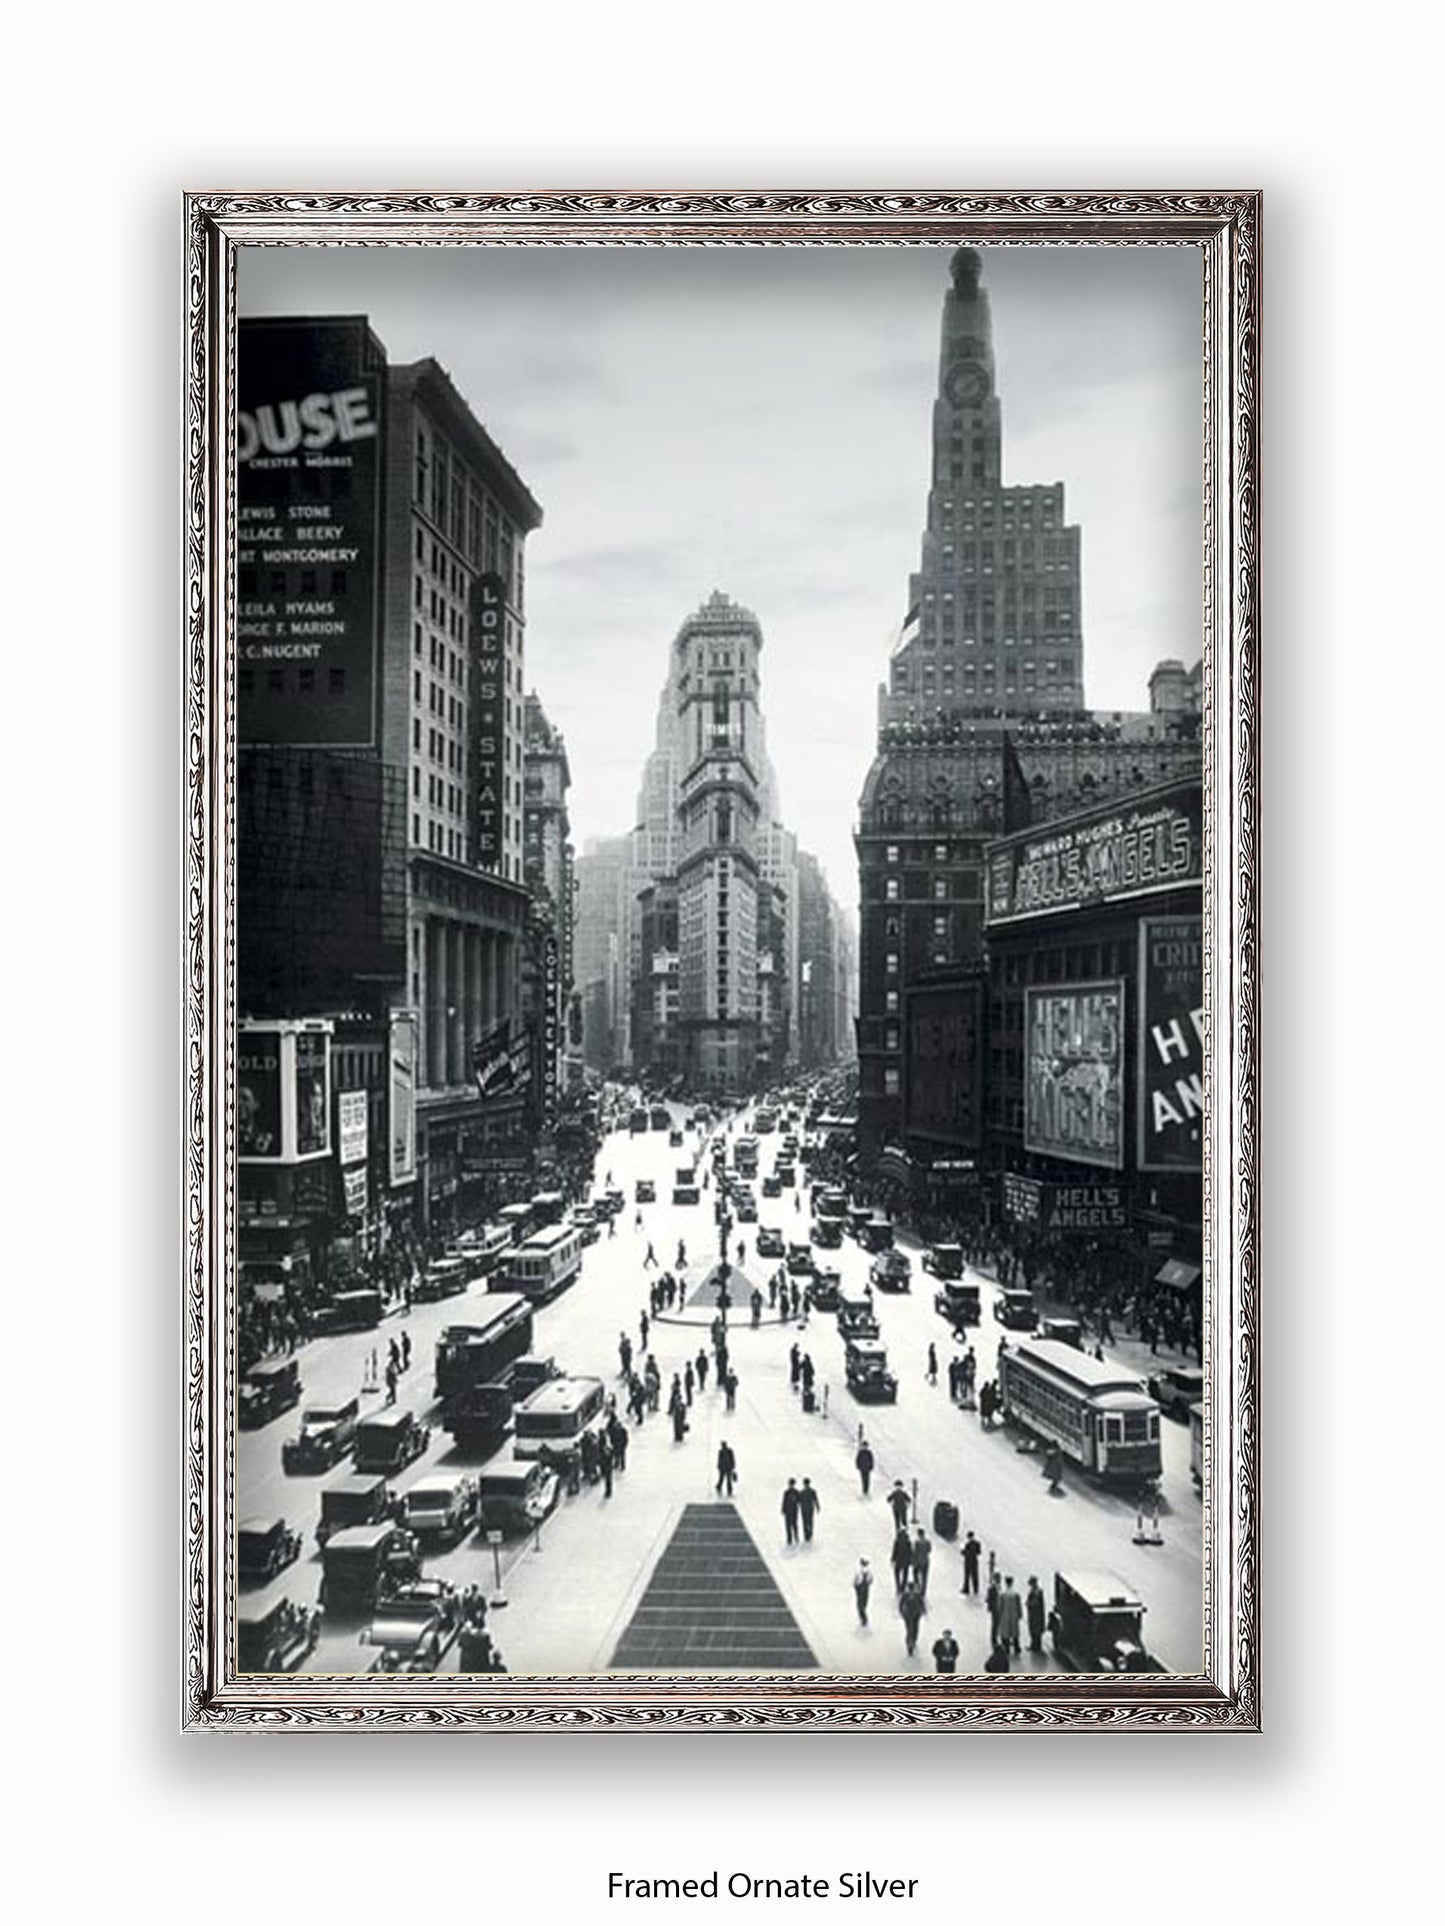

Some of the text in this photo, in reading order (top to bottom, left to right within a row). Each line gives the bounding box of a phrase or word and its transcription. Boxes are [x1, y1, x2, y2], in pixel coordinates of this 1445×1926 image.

[289, 506, 331, 519] STONE
[297, 526, 344, 540] BEERY
[262, 549, 359, 563] MONTGOMERY
[286, 602, 335, 615] HYAMS
[291, 621, 344, 635] MARION
[479, 736, 497, 850] STATE
[1056, 1188, 1120, 1207] HELL'S
[1050, 1208, 1126, 1228] ANGELS
